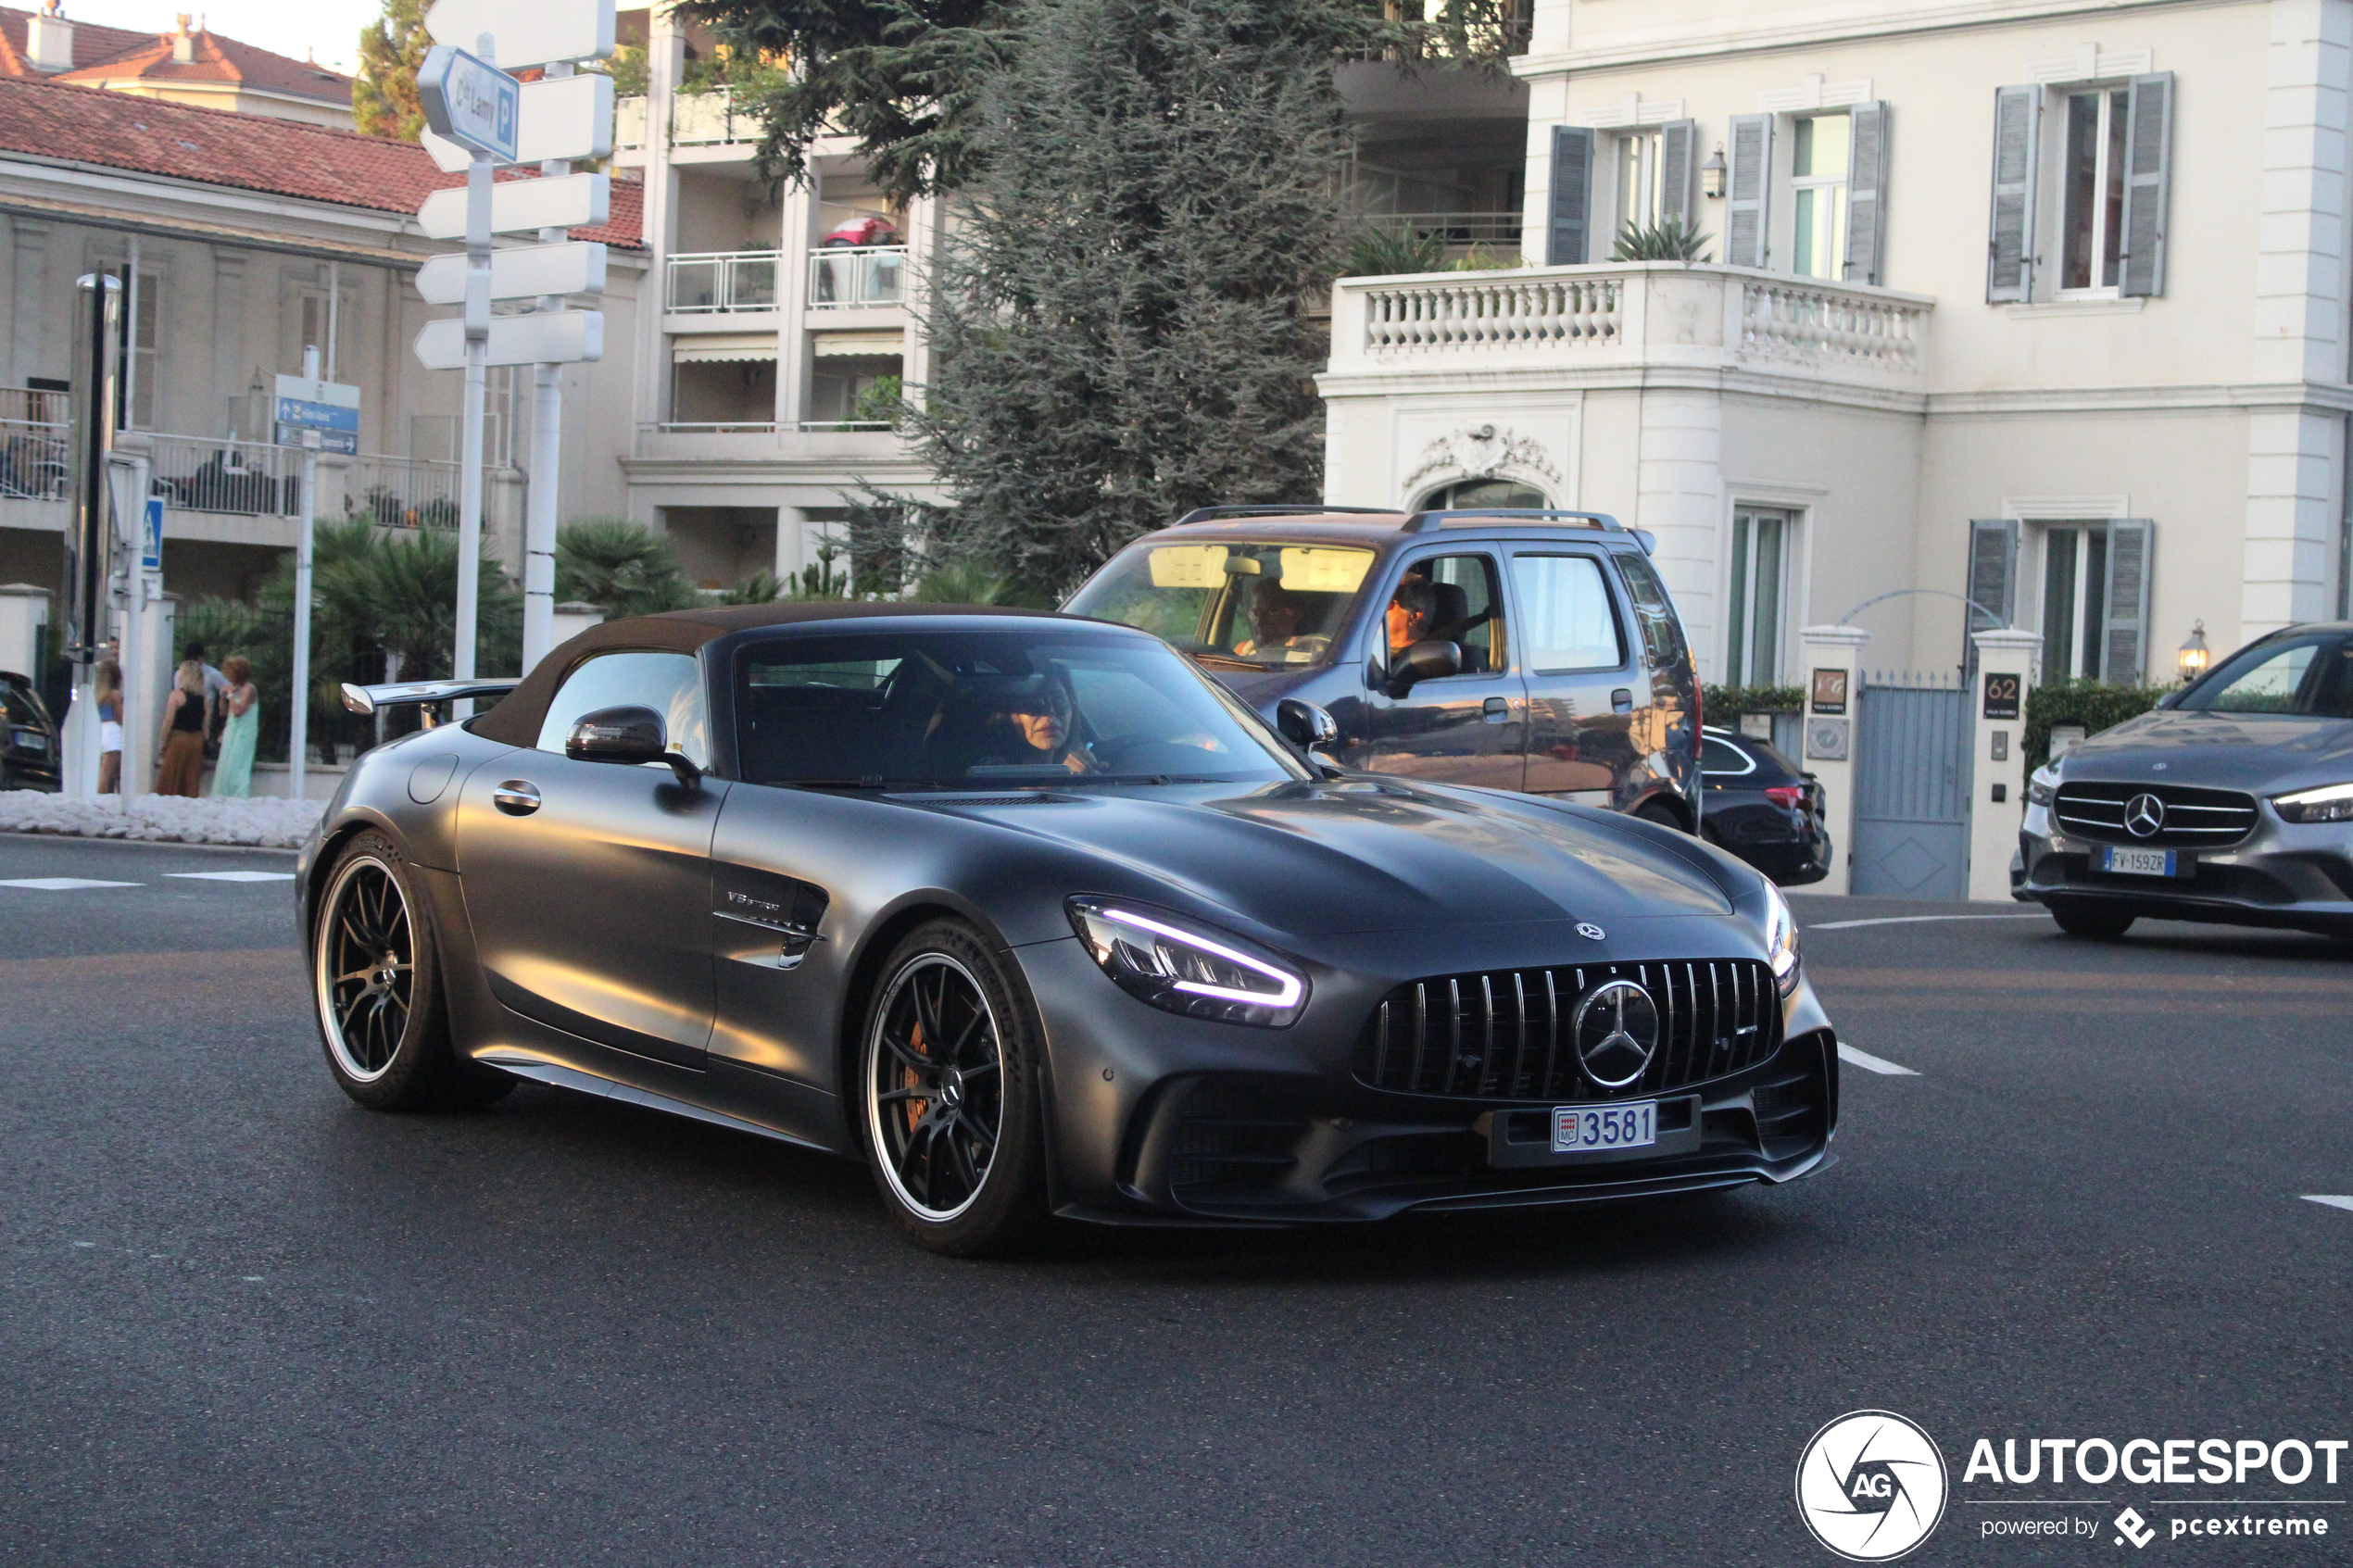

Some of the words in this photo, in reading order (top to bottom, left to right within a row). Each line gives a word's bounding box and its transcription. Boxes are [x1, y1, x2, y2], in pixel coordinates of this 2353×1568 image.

[471, 85, 495, 130] Lamy
[500, 97, 510, 133] P
[1988, 679, 2016, 699] 62
[1561, 1131, 1575, 1141] MC
[1583, 1107, 1650, 1146] 3581
